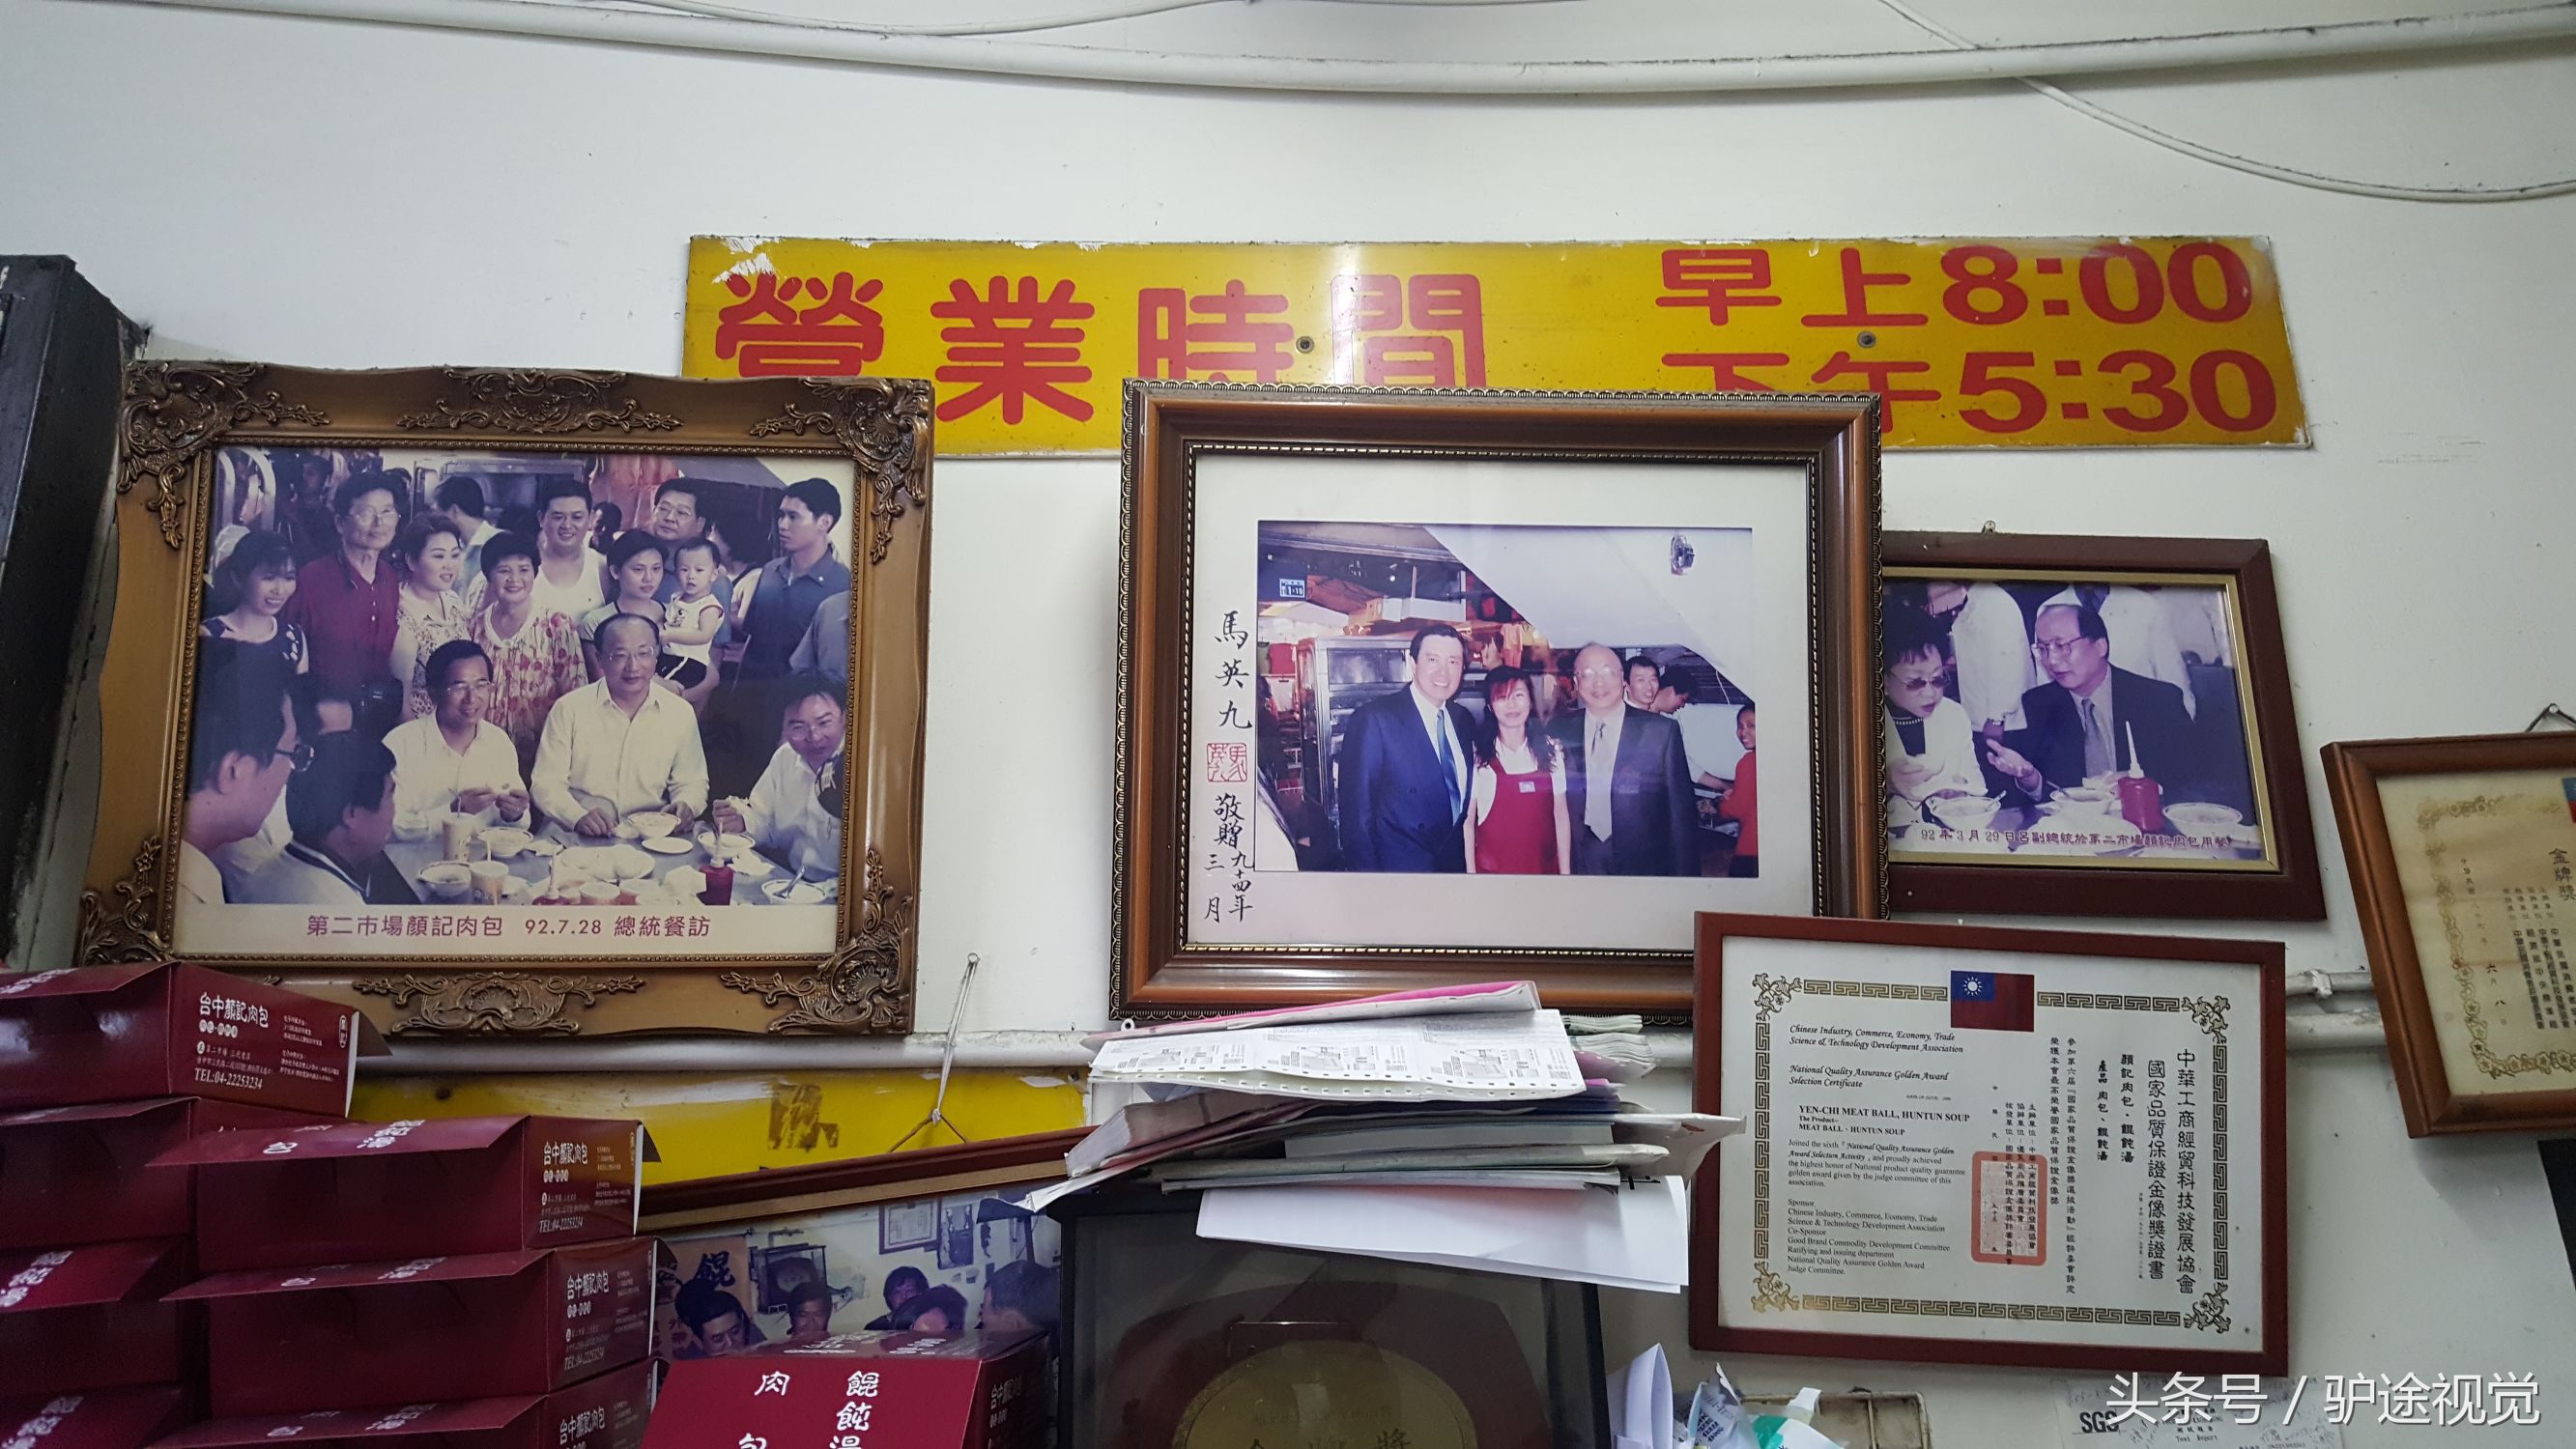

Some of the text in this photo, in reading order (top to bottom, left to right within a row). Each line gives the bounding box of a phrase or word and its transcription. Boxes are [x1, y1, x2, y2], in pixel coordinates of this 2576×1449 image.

[525, 919, 602, 936] 92.7.28
[614, 915, 711, 938] 總統餐訪
[1790, 1025, 1955, 1041] Chinese Industry, Commerce, Economy, Trade
[1789, 1037, 1816, 1045] Science
[1828, 1038, 1870, 1050] Technology
[1871, 1041, 1919, 1052] Development
[1921, 1044, 1963, 1053] Association
[1789, 1065, 1949, 1081] National Quality Assurance Golden Award
[1789, 1077, 1863, 1090] Selection Certificate
[1799, 1105, 1970, 1122] YEN-CHI MEAT BALL, HUNTUN SOUP
[2148, 1060, 2166, 1279] 國家品質保證金像獎證書
[2176, 1049, 2196, 1294] 中華工商經貿科技發展協會
[1788, 1199, 1815, 1208] Sponsor
[1818, 1258, 1841, 1266] Quality
[2080, 1410, 2120, 1434] SGS
